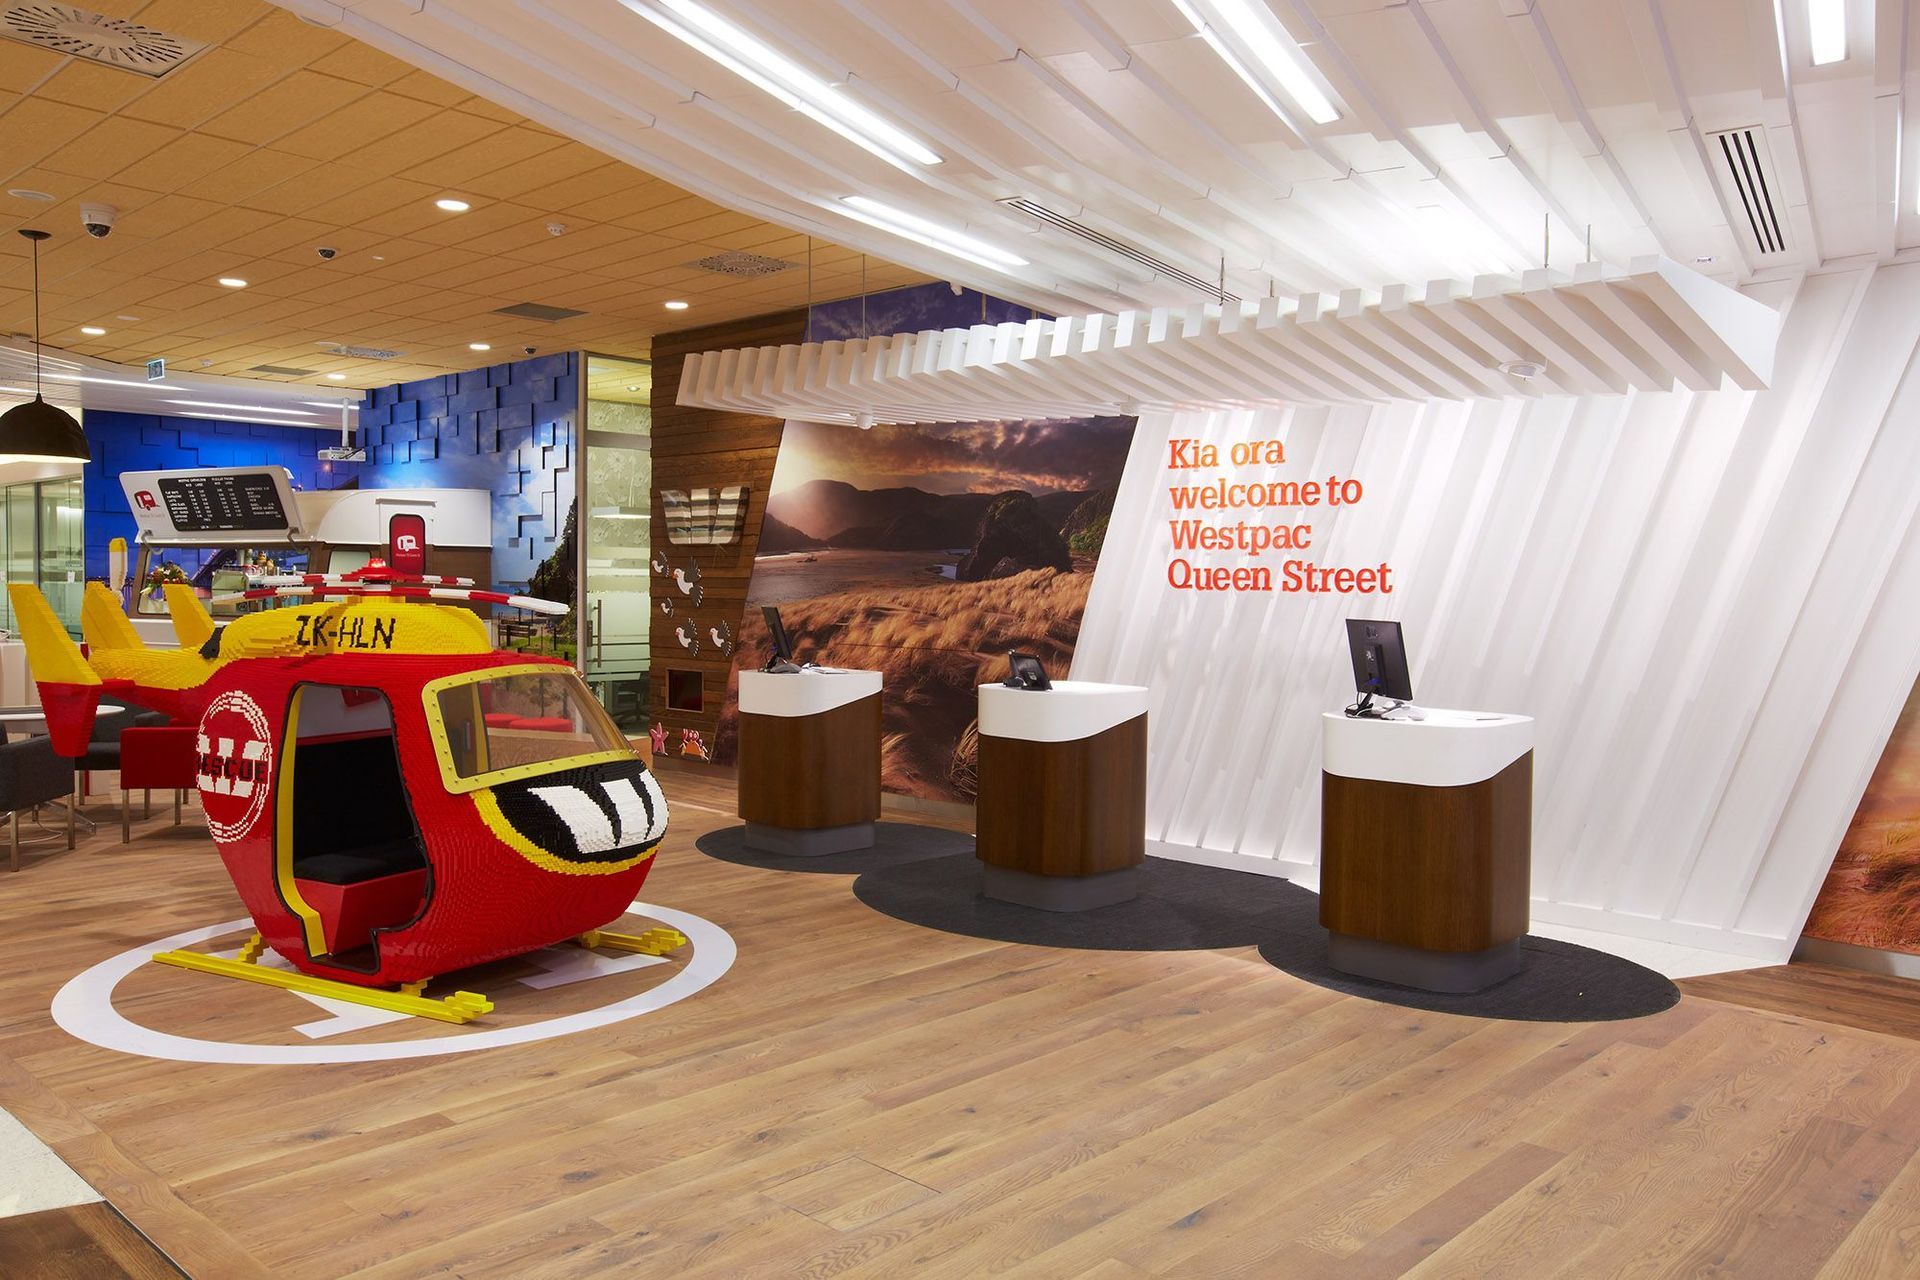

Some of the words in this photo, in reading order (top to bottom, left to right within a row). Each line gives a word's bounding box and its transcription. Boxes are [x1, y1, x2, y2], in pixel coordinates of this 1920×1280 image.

[1168, 439, 1219, 469] Kia
[1231, 439, 1285, 467] ora
[1169, 478, 1321, 510] welcome
[1326, 475, 1363, 506] to
[1169, 520, 1311, 556] Westpac
[1168, 559, 1272, 591] Queen
[1282, 560, 1393, 593] Street
[296, 615, 396, 649] ZK-HLN
